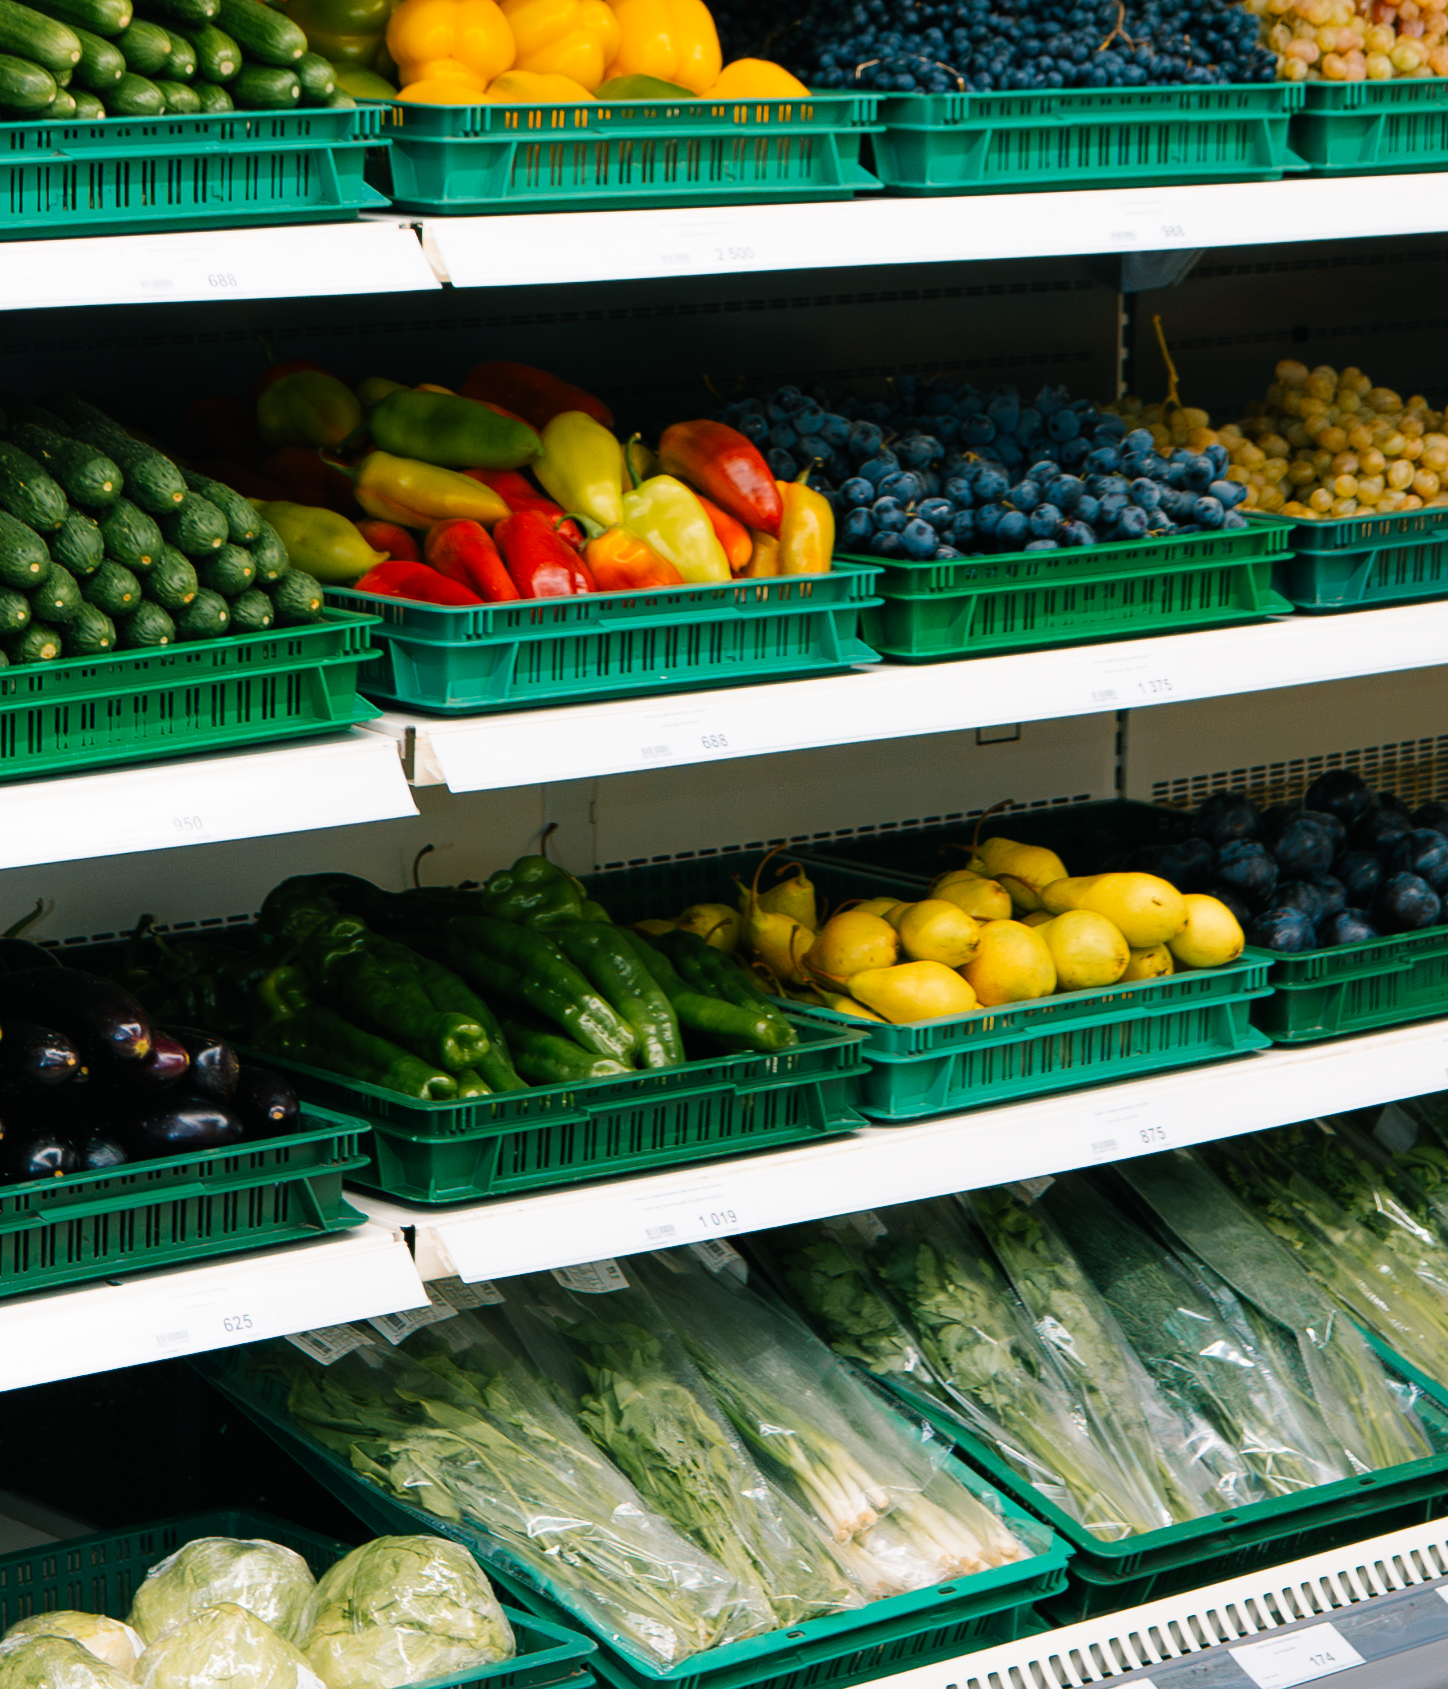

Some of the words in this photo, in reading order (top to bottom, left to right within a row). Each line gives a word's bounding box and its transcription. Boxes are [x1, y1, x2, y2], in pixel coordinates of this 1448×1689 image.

[728, 246, 755, 260] 500
[208, 274, 238, 288] 688
[1152, 678, 1173, 693] 375
[701, 733, 729, 750] 688
[173, 815, 203, 833] 950
[1140, 1126, 1166, 1143] 875
[711, 1210, 737, 1226] 019
[223, 1314, 253, 1333] 625
[1309, 1652, 1336, 1667] 174
